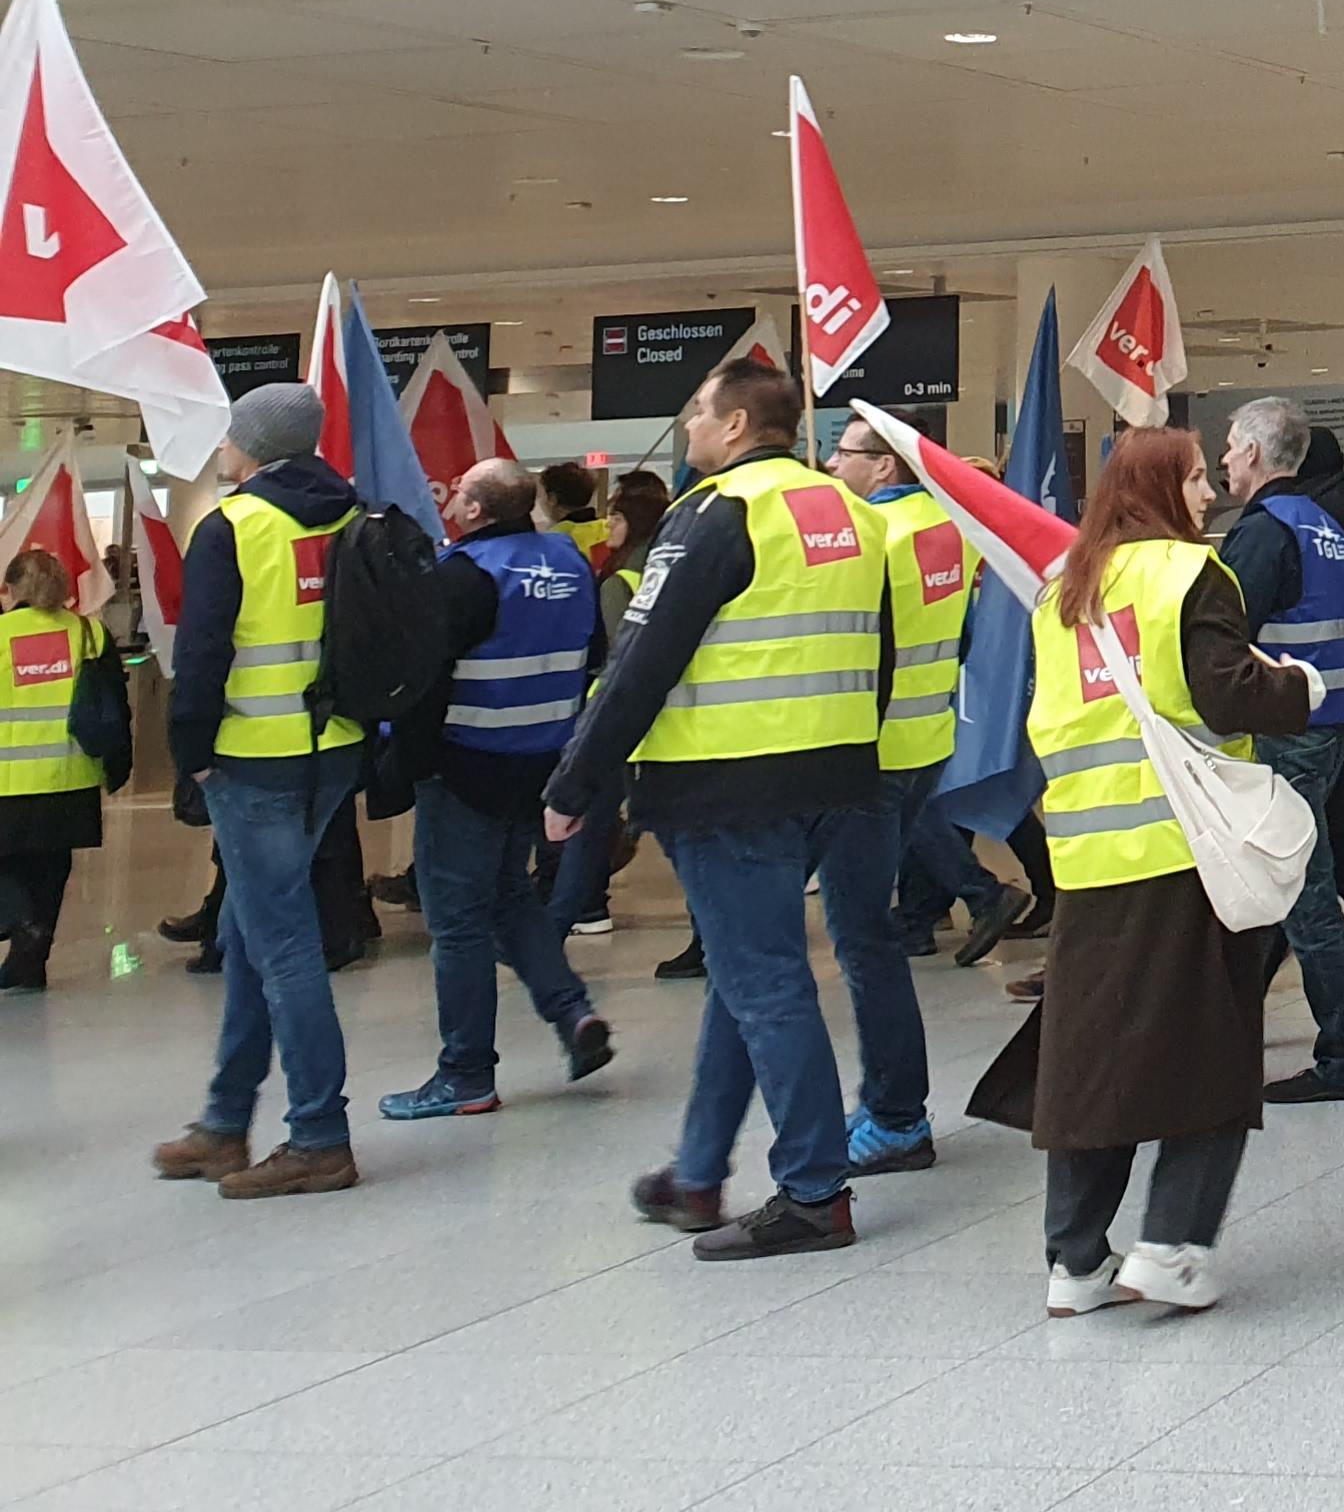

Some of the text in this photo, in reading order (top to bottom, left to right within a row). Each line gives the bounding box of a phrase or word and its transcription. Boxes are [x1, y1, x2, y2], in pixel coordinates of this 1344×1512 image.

[637, 323, 723, 342] Geschlossen
[637, 346, 683, 363] Closed
[904, 381, 952, 396] 0-3 min
[803, 527, 855, 551] ver.di
[924, 564, 961, 588] ver.di
[16, 660, 69, 677] ver.di
